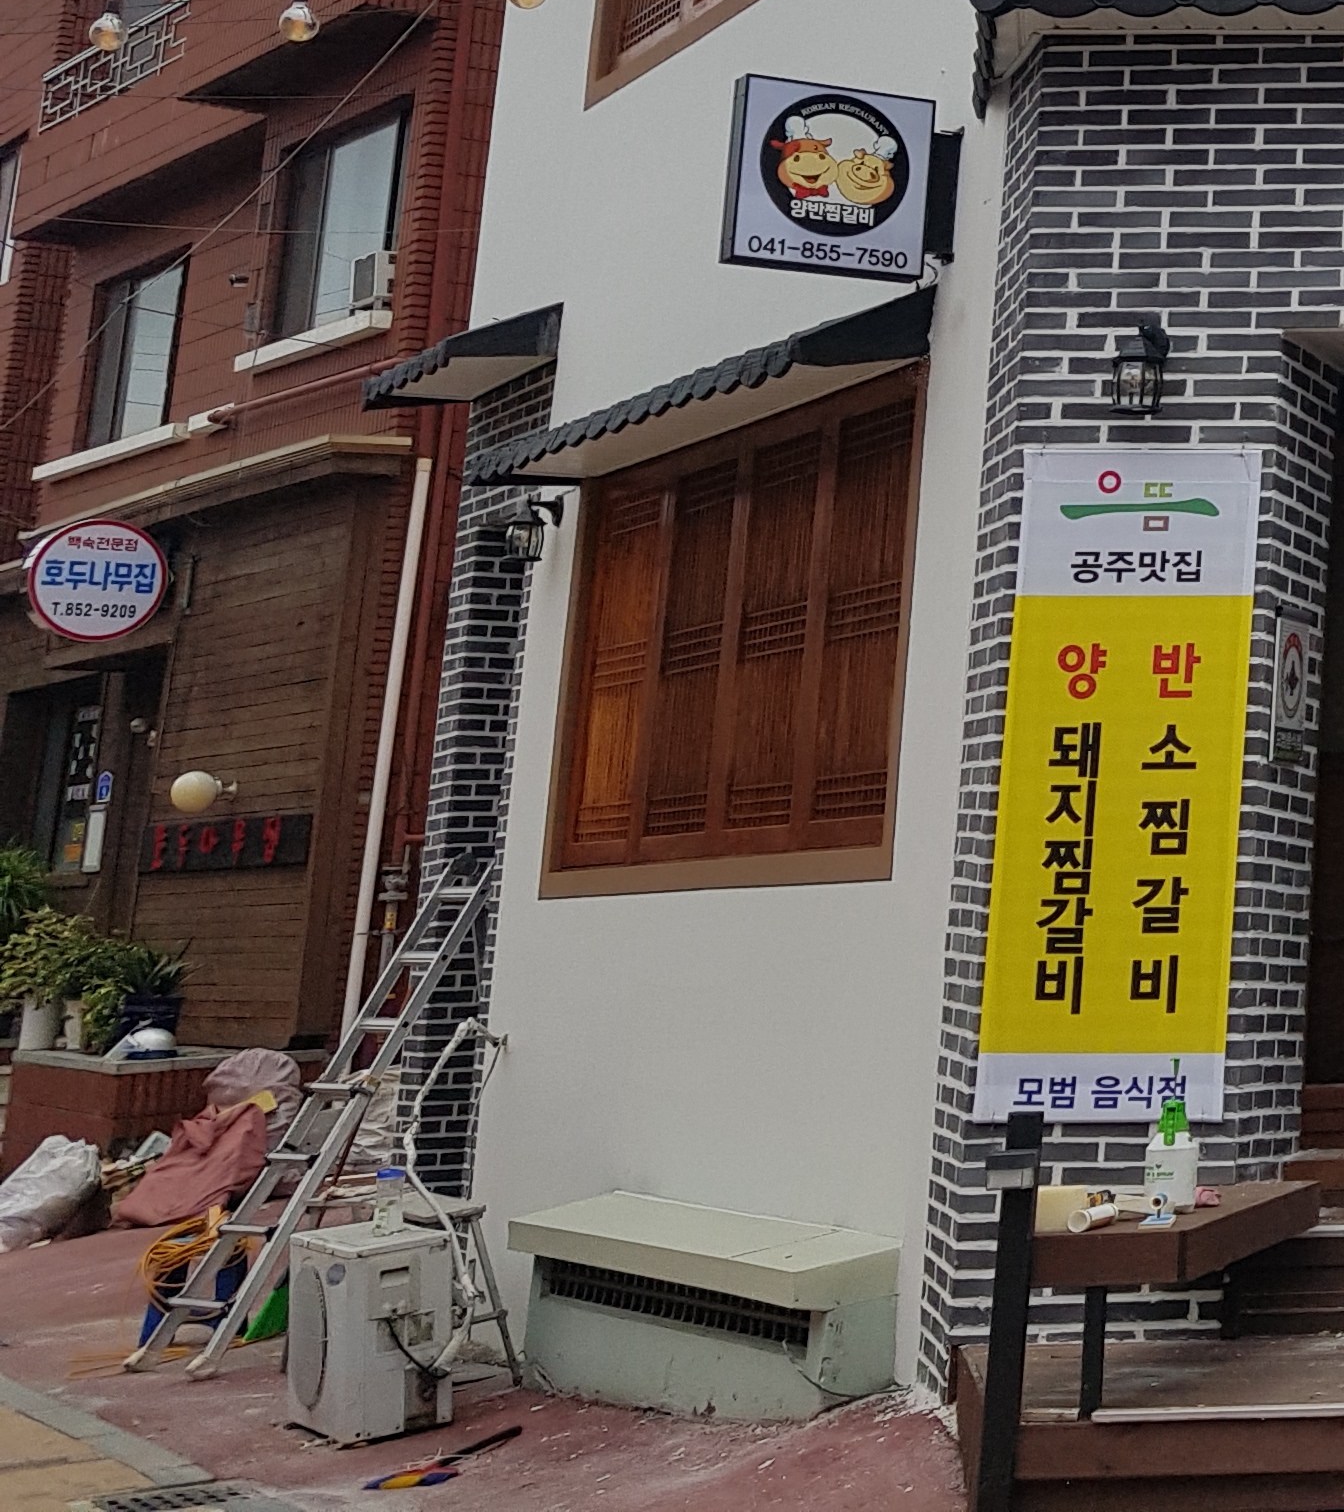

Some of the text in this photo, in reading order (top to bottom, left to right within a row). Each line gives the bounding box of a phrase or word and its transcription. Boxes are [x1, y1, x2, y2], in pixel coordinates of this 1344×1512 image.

[801, 102, 889, 136] KOREAN RESTAURANT
[790, 199, 875, 226] 양반찜갈비
[748, 236, 908, 269] 041-855-7590
[68, 536, 139, 552] 백숙전문점
[41, 560, 156, 594] 호두나무집
[1070, 550, 1203, 583] 공주맛집
[52, 602, 136, 618] T.852-9209
[1034, 722, 1102, 1015] 돼지찜갈비
[1012, 1075, 1188, 1109] 모범 음식점
